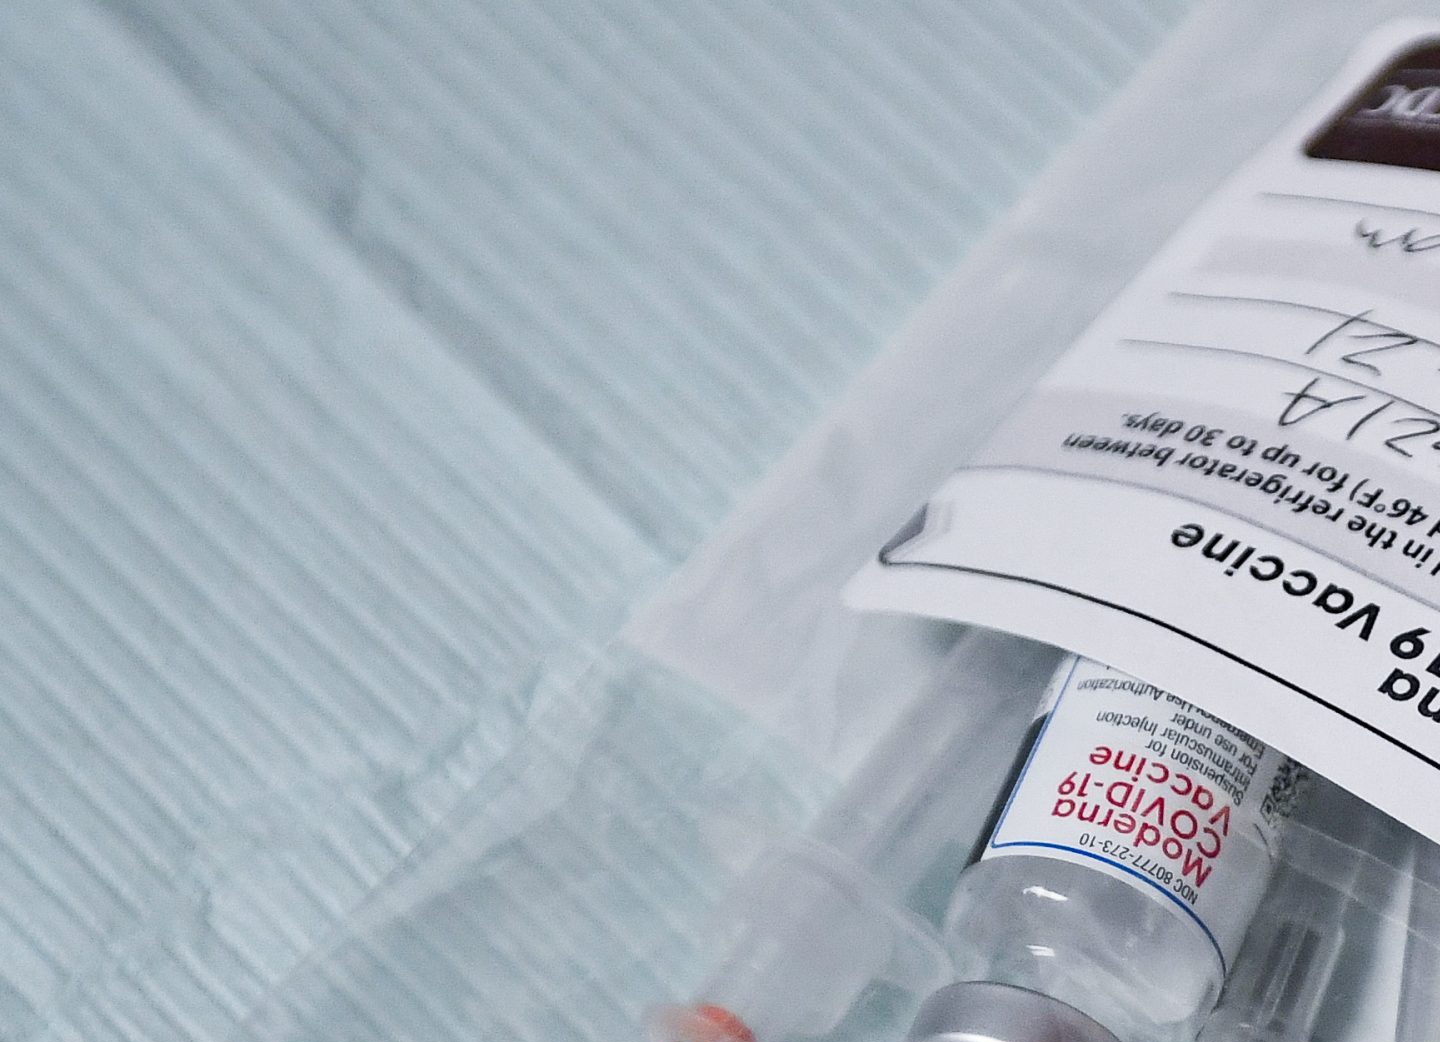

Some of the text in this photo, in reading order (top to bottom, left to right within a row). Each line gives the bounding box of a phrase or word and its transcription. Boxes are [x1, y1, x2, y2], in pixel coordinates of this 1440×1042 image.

[1121, 411, 1186, 440] days.
[1183, 425, 1225, 447] 30
[1226, 435, 1258, 457] to
[1062, 434, 1176, 468] between
[1260, 444, 1301, 469] up
[1174, 438, 1345, 523] refrigerator
[1301, 462, 1350, 493] for
[1347, 514, 1398, 551] the
[1402, 539, 1435, 569] in
[1170, 523, 1381, 642] Vaccine
[1077, 680, 1166, 702] Authorization
[1095, 711, 1253, 793] Intramuscular Injection
[1169, 712, 1259, 776] For use under
[1089, 746, 1232, 838] Vaccine
[1144, 738, 1248, 808] Suspension for
[1057, 771, 1227, 860] COVID-19
[1051, 798, 1214, 890] Moderna
[1078, 833, 1199, 906] NDC 80777-273-10
